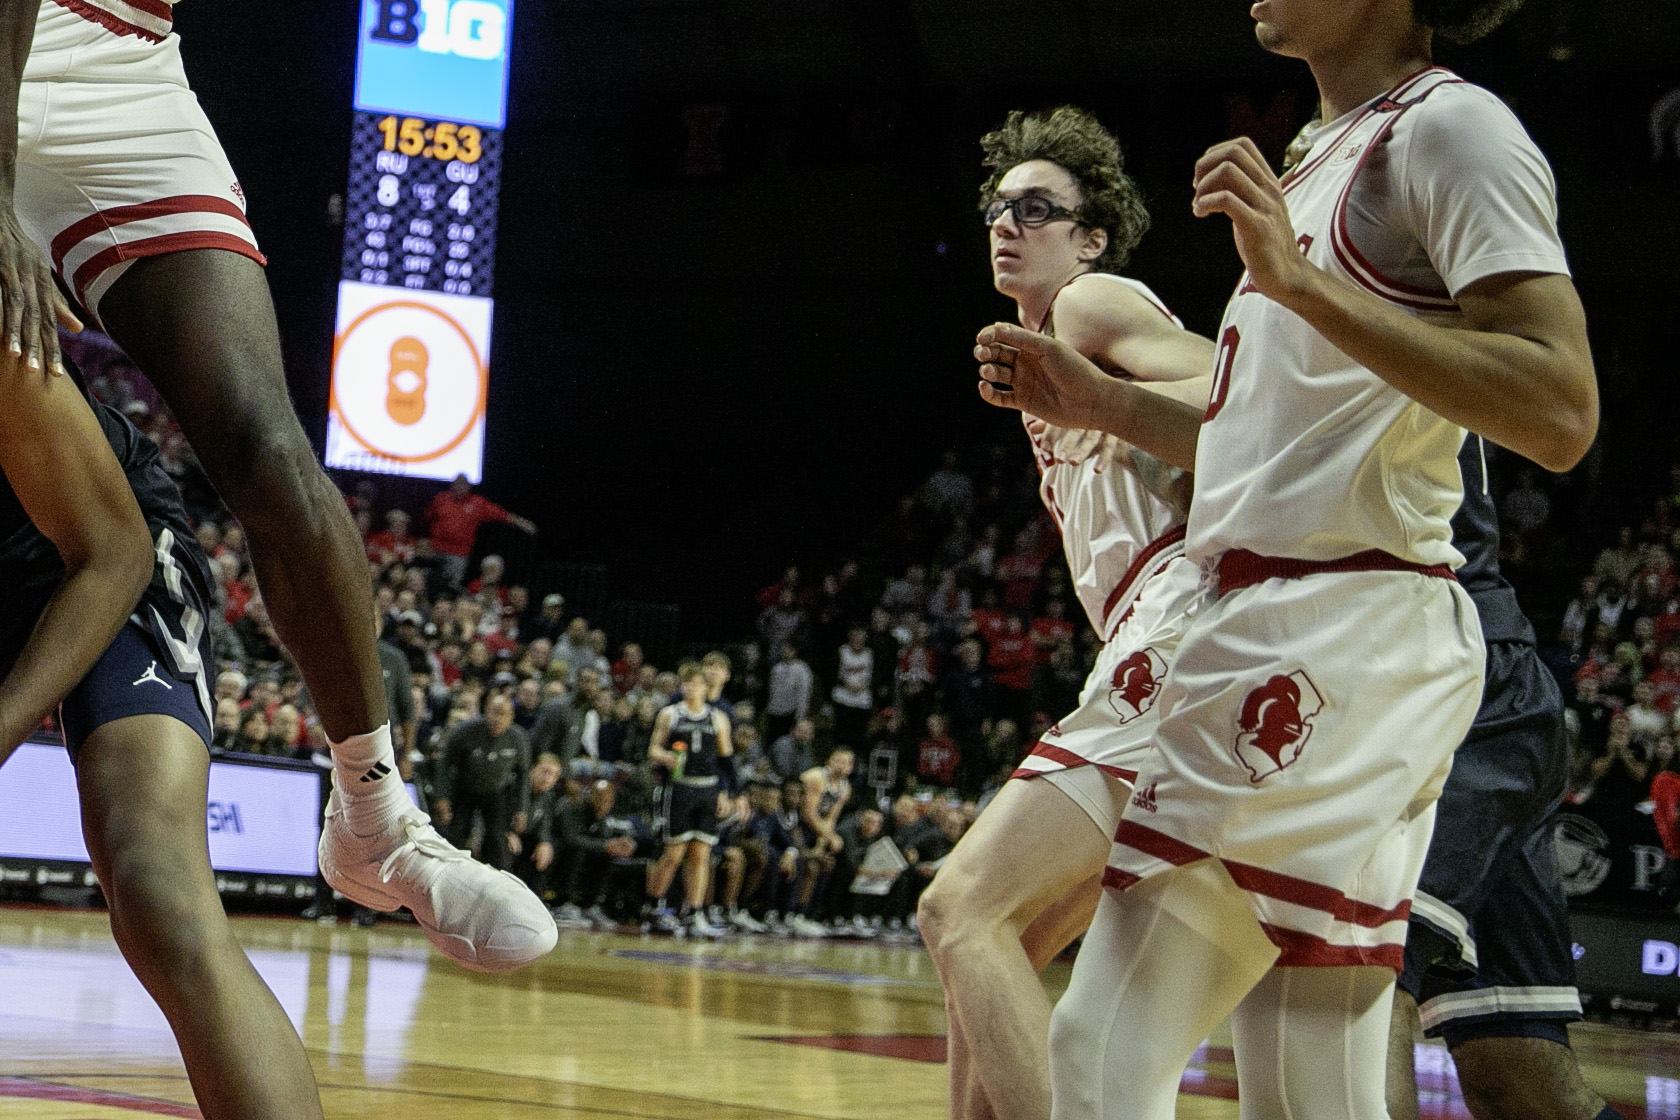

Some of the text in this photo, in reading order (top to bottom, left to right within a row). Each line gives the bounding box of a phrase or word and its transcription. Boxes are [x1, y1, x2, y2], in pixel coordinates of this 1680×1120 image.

[377, 115, 483, 164] 15:53
[376, 174, 401, 208] 8
[447, 184, 471, 217] 4
[1640, 938, 1680, 977] D
